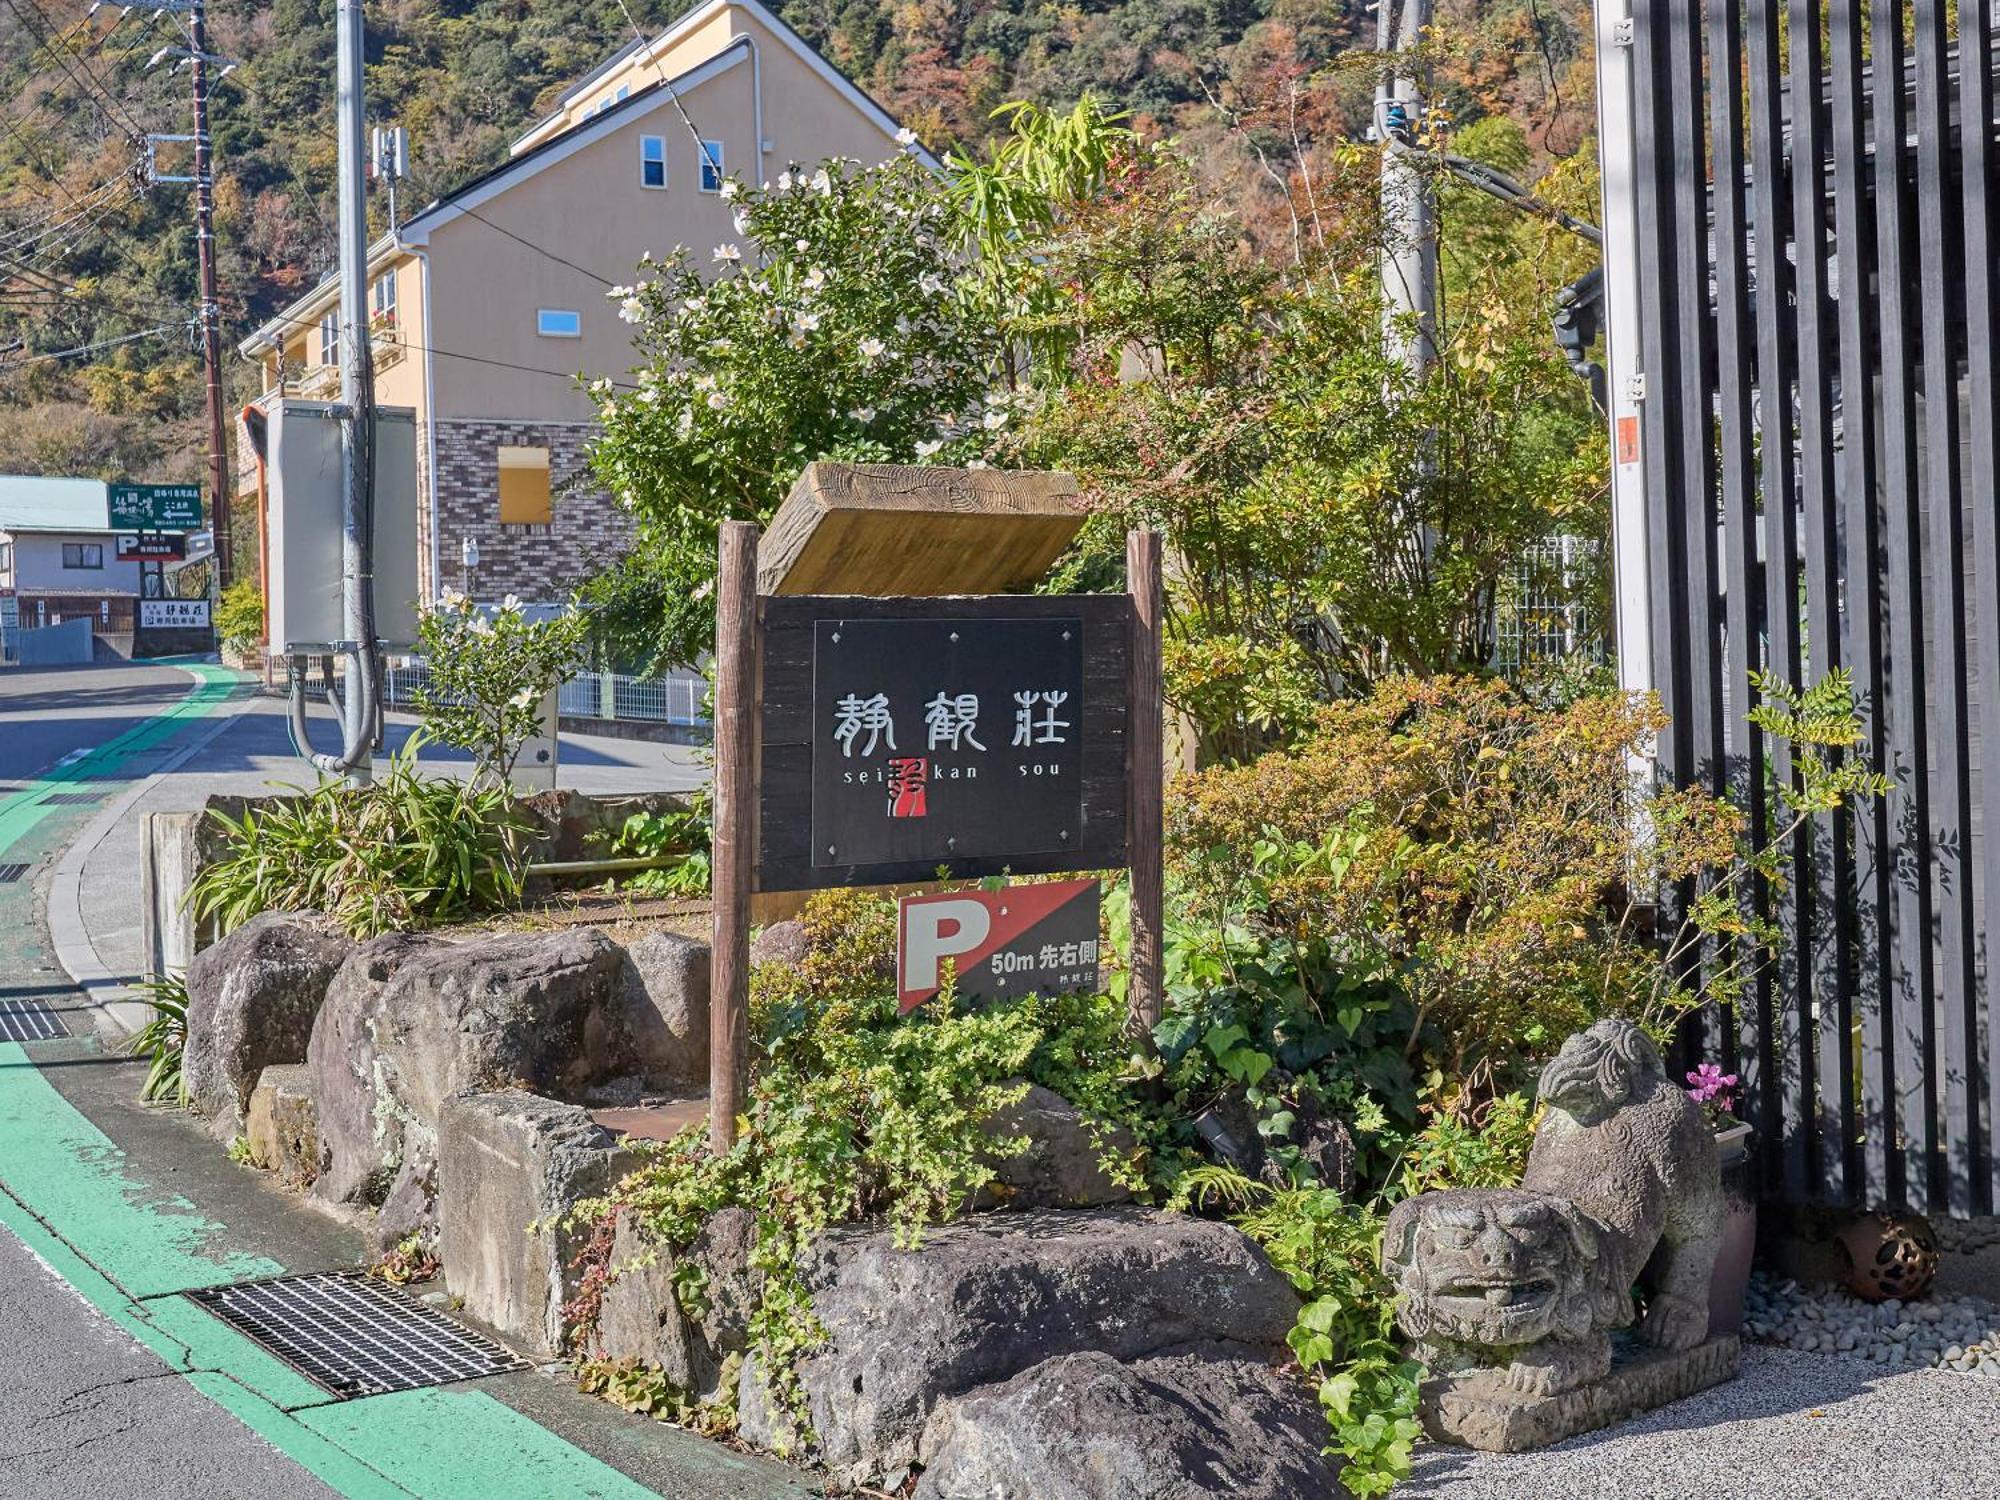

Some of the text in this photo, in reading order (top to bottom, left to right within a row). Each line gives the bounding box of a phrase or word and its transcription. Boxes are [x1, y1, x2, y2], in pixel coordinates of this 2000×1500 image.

[118, 535, 139, 554] P
[843, 763, 1060, 784] sei kan sou
[904, 899, 991, 992] P
[991, 939, 1097, 975] 50m 先右側
